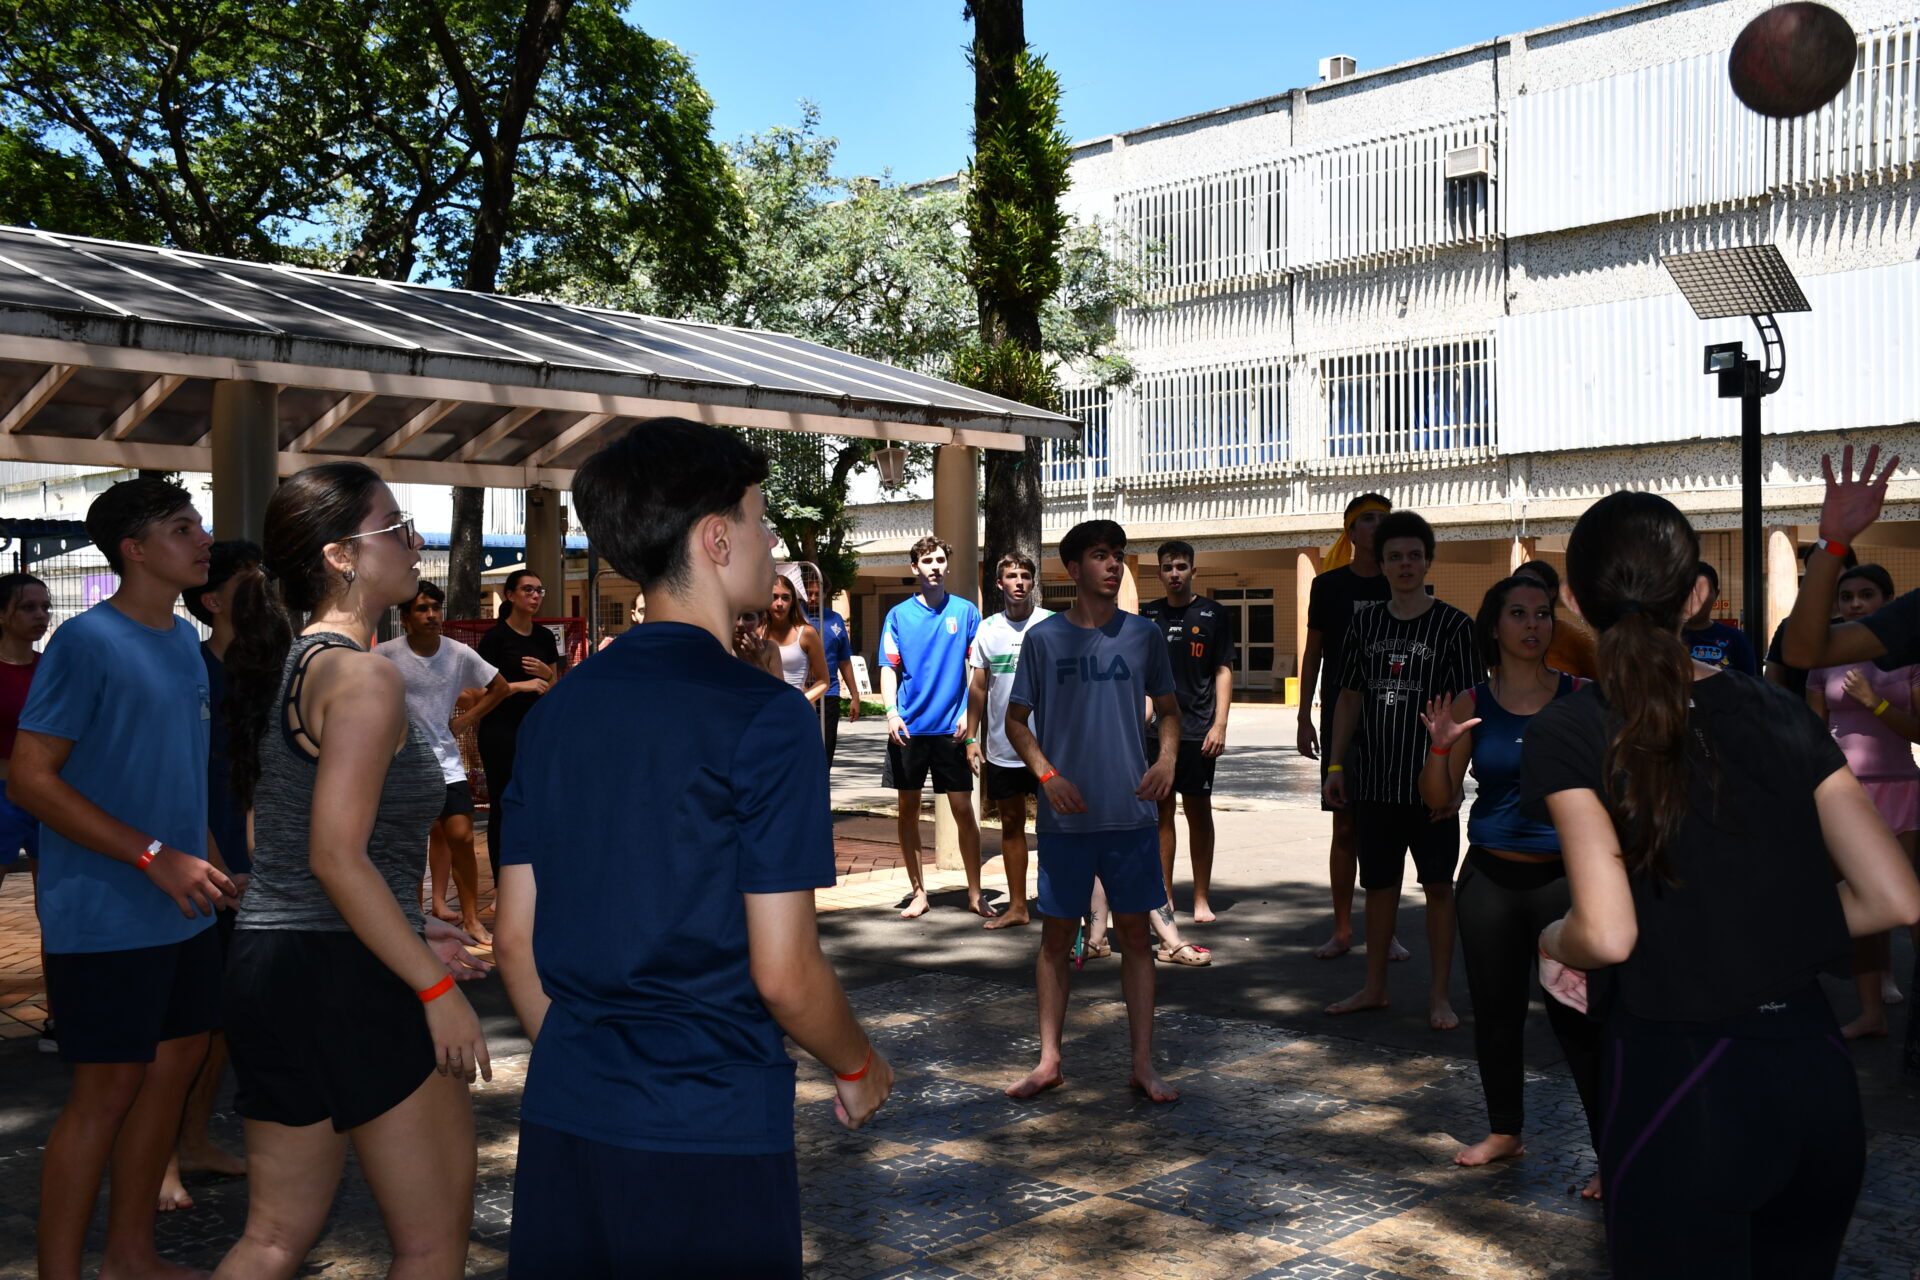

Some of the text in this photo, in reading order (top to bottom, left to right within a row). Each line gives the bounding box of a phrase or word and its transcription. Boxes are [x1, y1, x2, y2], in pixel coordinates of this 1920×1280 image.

[1190, 641, 1205, 658] 10
[1364, 638, 1435, 660] WINDY CITY
[1056, 654, 1131, 685] FILA
[1367, 678, 1424, 692] BASKETBALL
